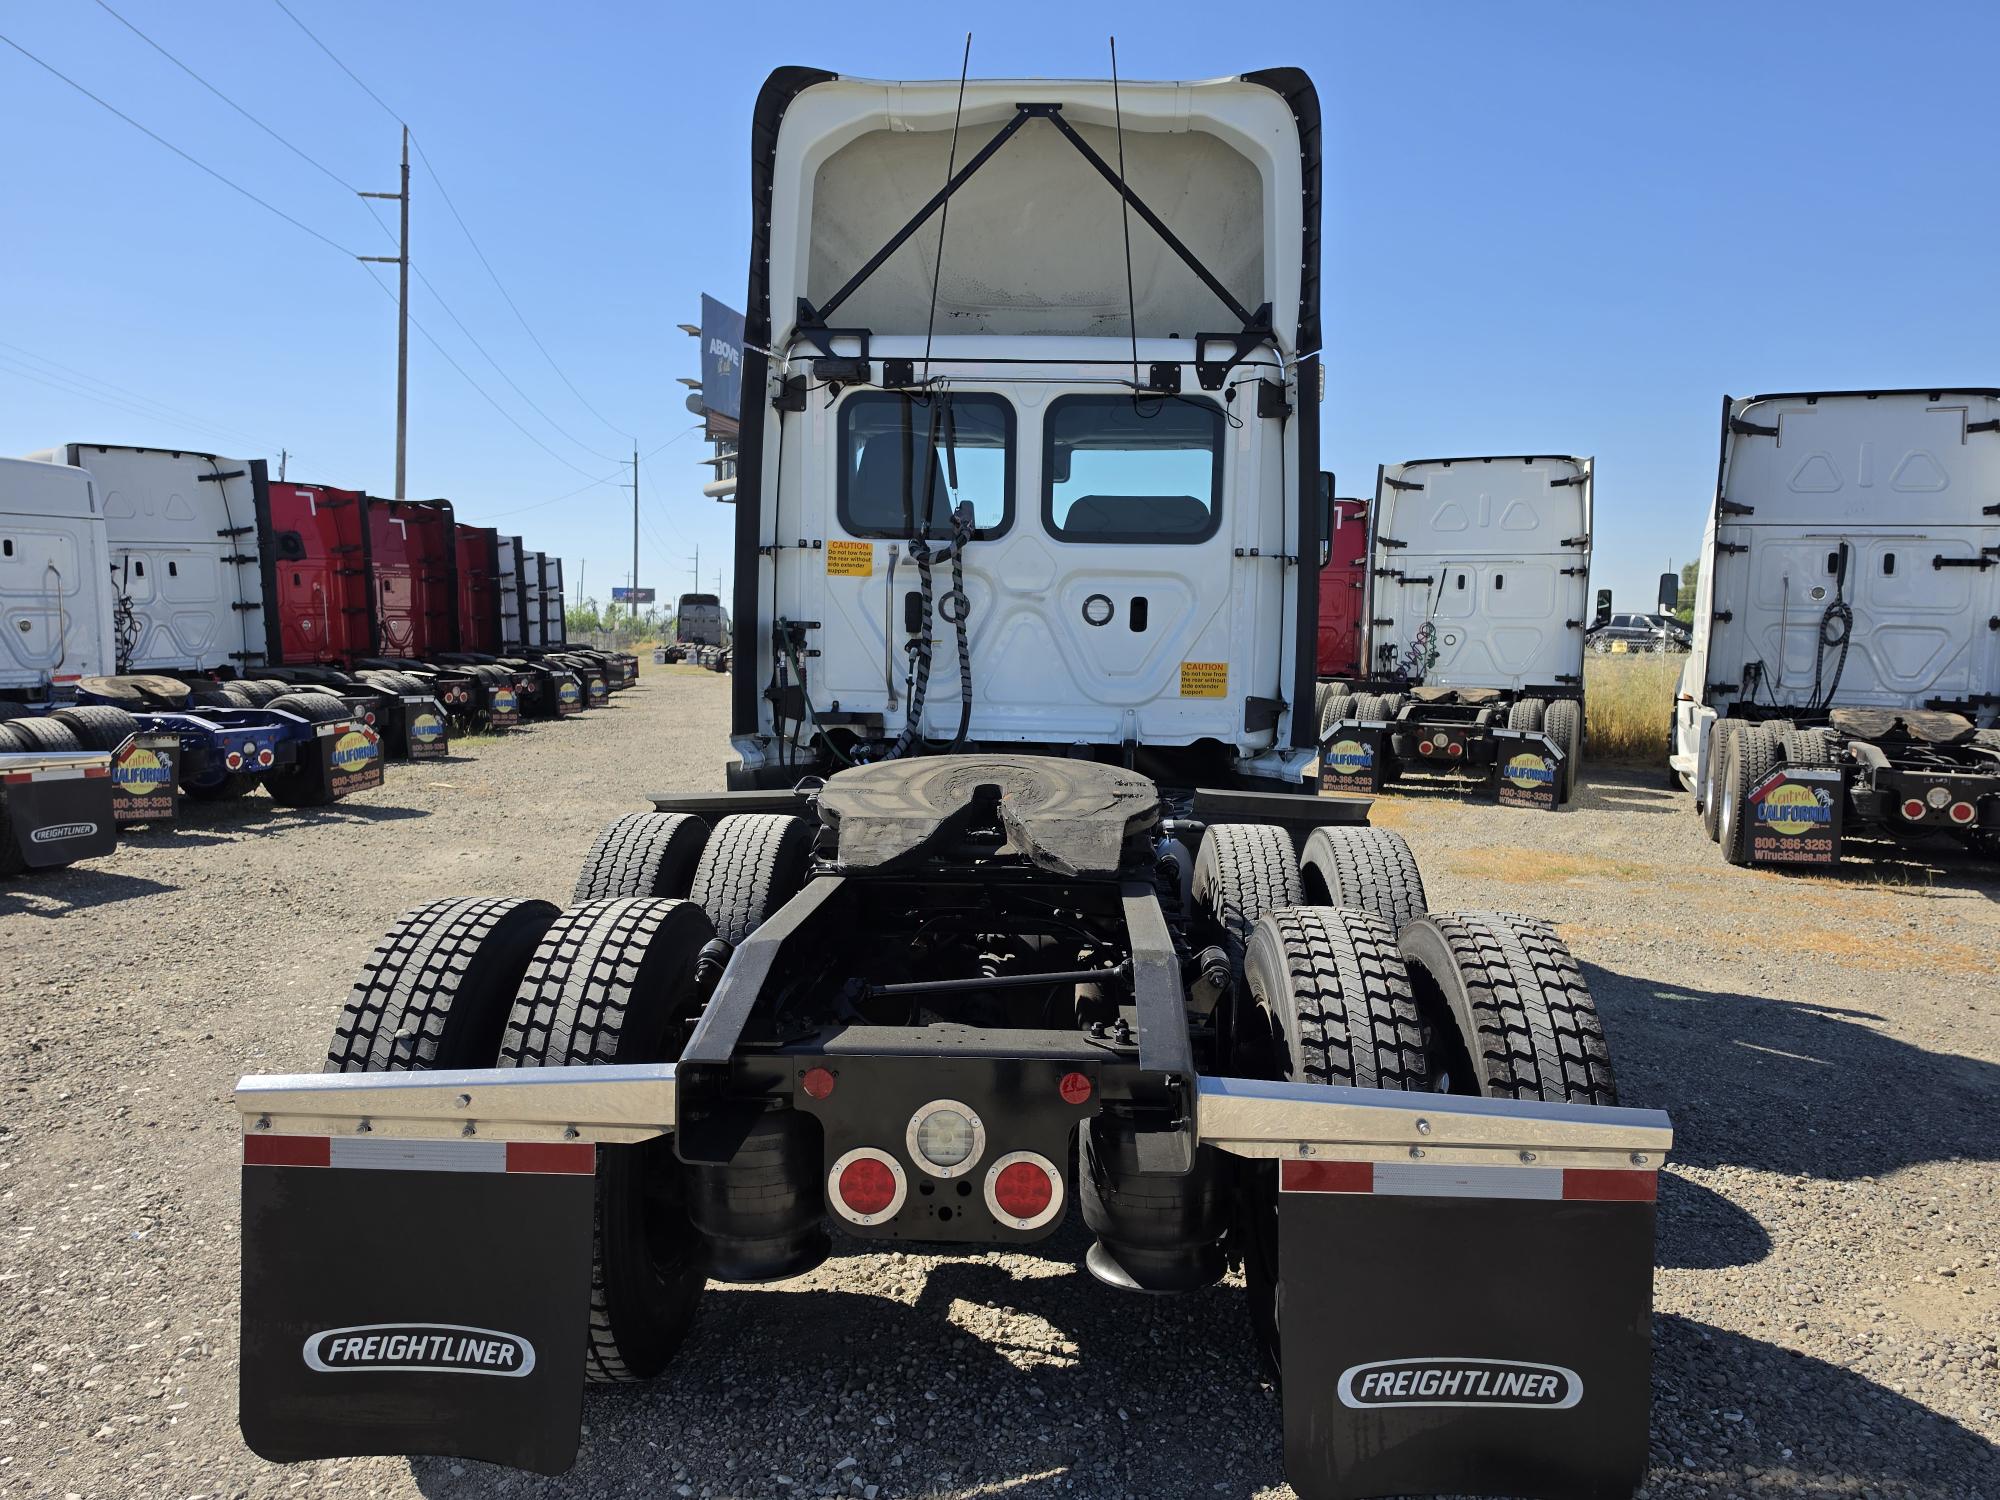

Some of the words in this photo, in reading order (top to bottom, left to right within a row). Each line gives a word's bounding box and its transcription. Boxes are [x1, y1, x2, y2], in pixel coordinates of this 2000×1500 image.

[709, 337, 739, 367] ABOVE
[832, 541, 869, 549] CAUTION
[332, 743, 378, 765] CALIFORNIA
[1326, 753, 1373, 767] CALIFORNIA
[112, 767, 171, 783] CALIFORNIA
[1504, 765, 1553, 782] CALIFORNIA
[1500, 787, 1552, 801] 800-366-3263
[1765, 786, 1812, 805] Central
[1757, 802, 1831, 822] CALIFORNIA
[37, 825, 91, 839] FREIGHTLINER
[1754, 837, 1832, 851] 800-366-3263
[1754, 849, 1832, 862] WTruckSales.net
[328, 1335, 515, 1366] FREIGHTLINER
[1360, 1370, 1559, 1398] FREIGHTLINER
